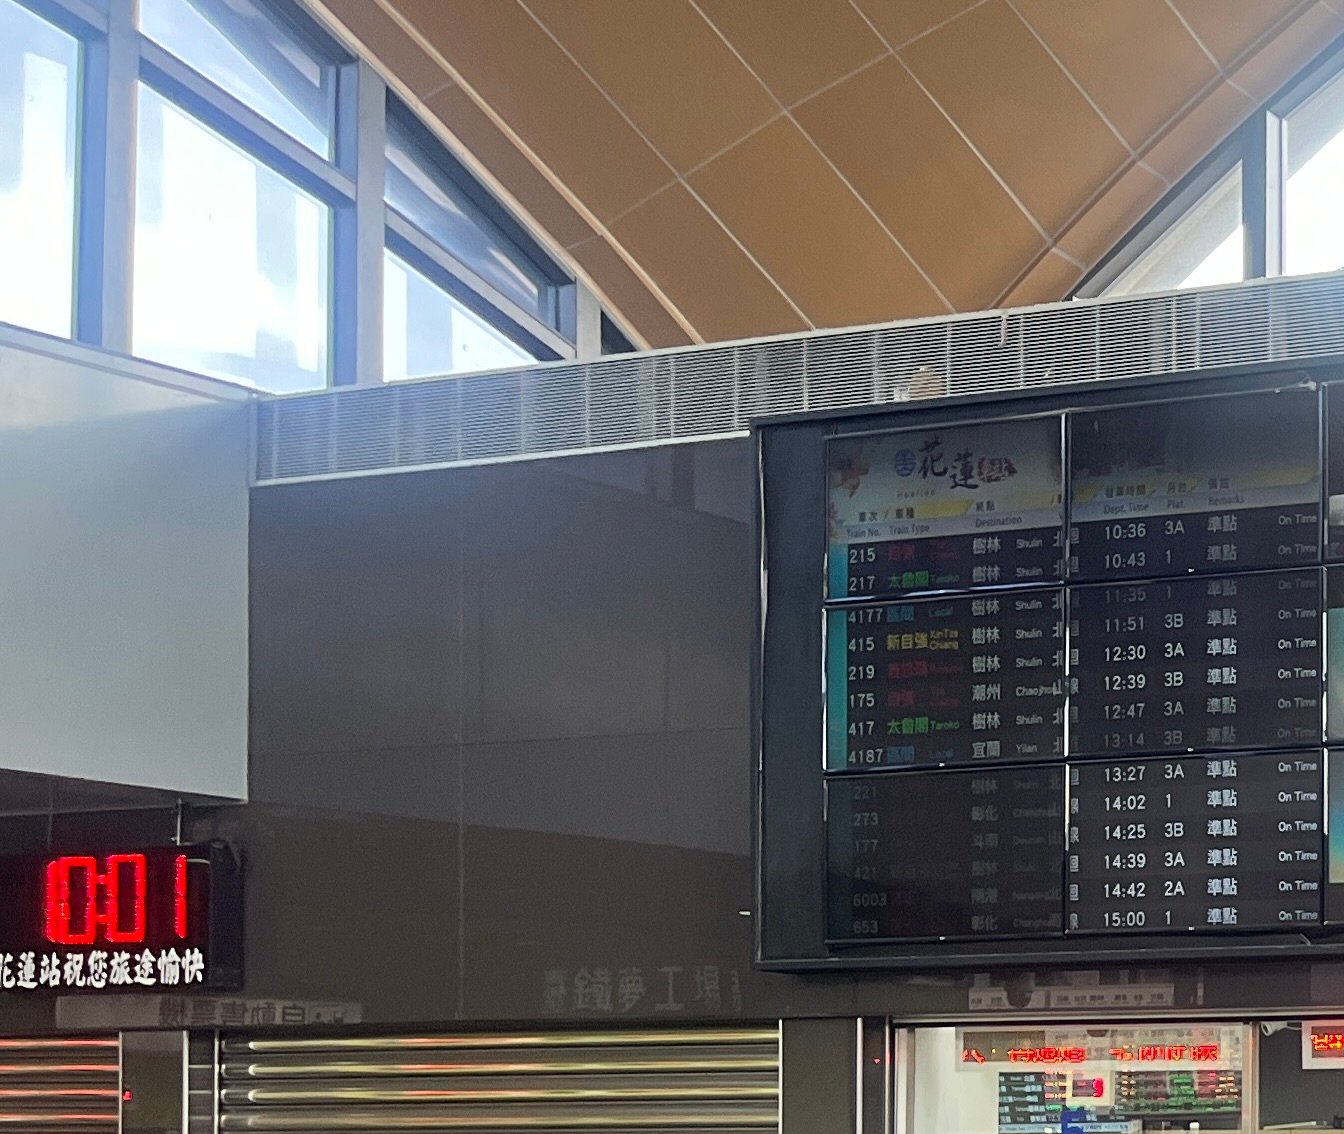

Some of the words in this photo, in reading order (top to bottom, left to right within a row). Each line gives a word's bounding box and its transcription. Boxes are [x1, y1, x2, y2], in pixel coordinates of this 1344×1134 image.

[849, 547, 876, 564] 215
[1105, 523, 1146, 540] 10:36
[1164, 519, 1185, 536] 3A
[849, 575, 876, 592] 217
[1105, 552, 1146, 569] 10:43
[848, 636, 875, 652] 415
[1105, 616, 1145, 632] 11:51
[1164, 613, 1184, 629] 3B
[848, 665, 875, 681] 219
[1105, 645, 1146, 662] 12:30
[1164, 642, 1185, 658] 3A
[849, 693, 875, 708] 175
[1105, 673, 1146, 691] 12:39
[1164, 671, 1184, 687] 3B
[848, 721, 875, 736] 417
[1104, 703, 1145, 720] 12:47
[848, 748, 883, 764] 4187
[1104, 766, 1146, 782] 13:27
[1164, 764, 1185, 779] 3A
[1104, 795, 1146, 811] 14:02
[1165, 793, 1171, 808] 1
[1104, 824, 1146, 840] 14:25
[1164, 822, 1184, 838] 3B
[1104, 852, 1147, 869] 14:39
[1164, 851, 1186, 867] 3A
[1104, 882, 1146, 898] 14:42
[1164, 881, 1185, 896] 2A
[1104, 911, 1146, 927] 15:00
[1165, 910, 1171, 925] 1
[0, 947, 205, 988] 花蓮站祝您旅途愉快
